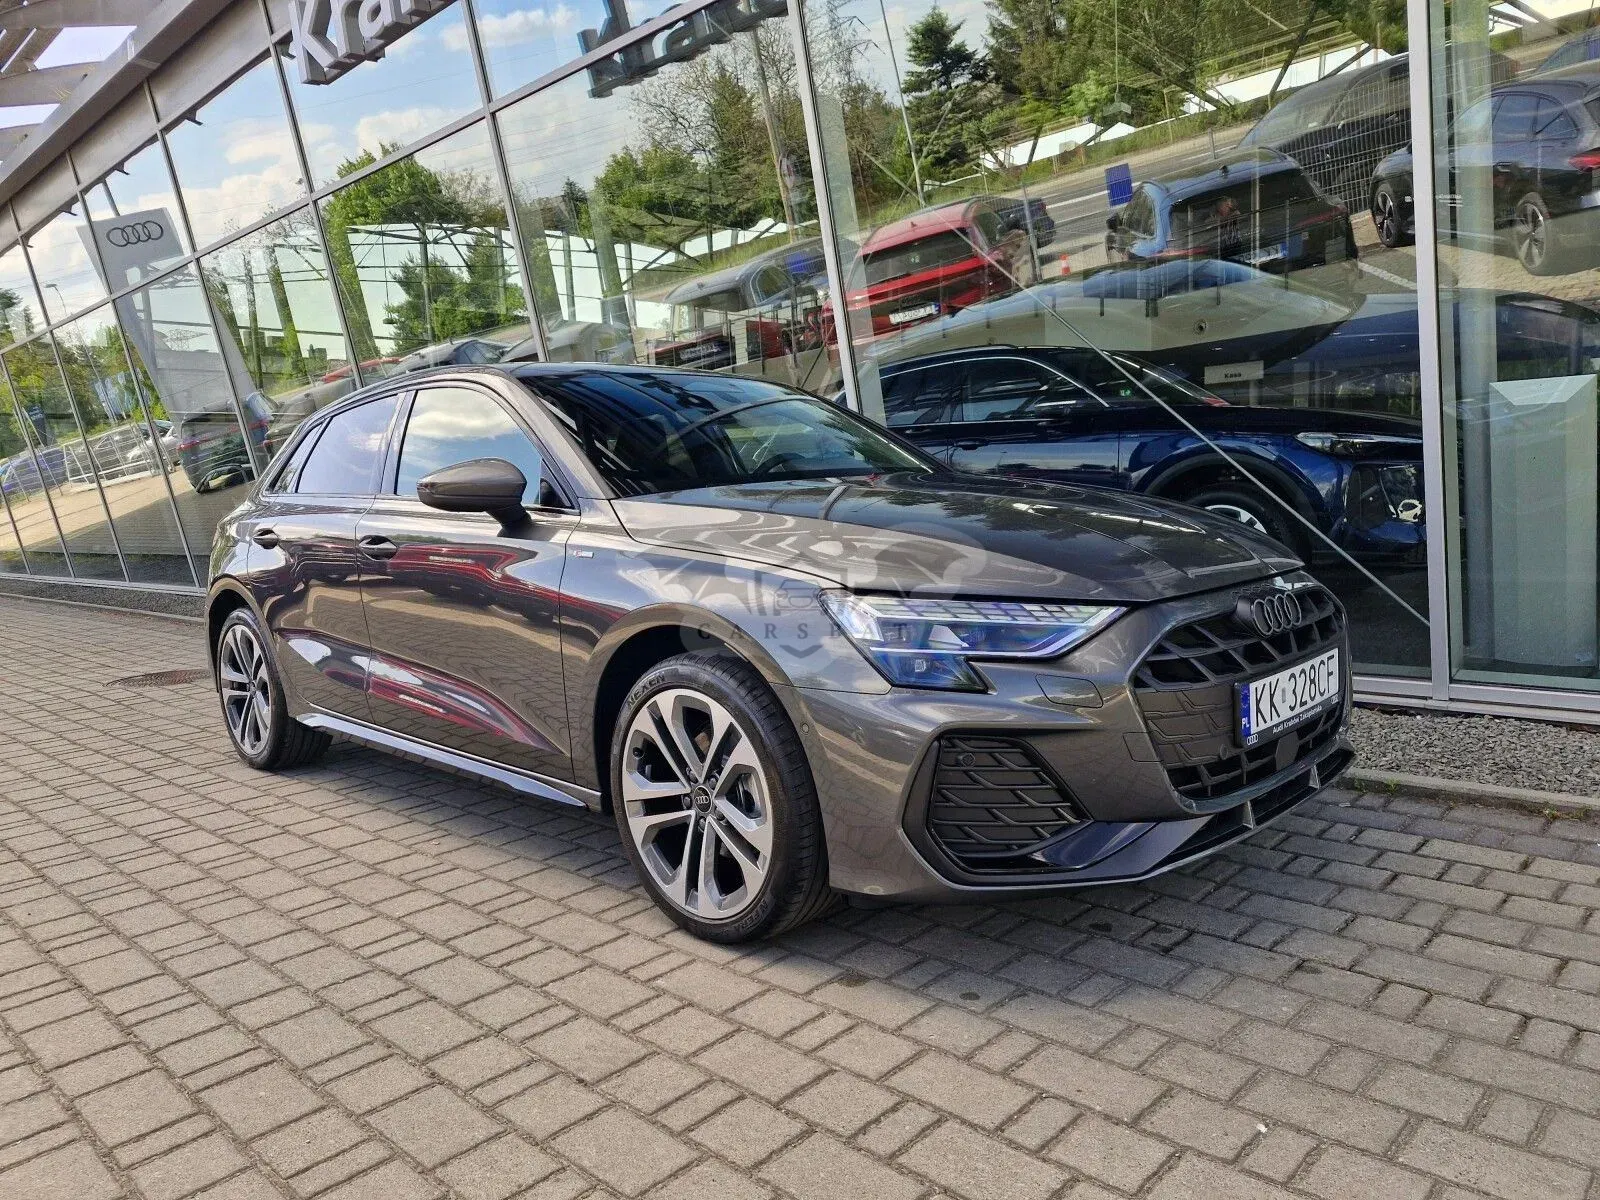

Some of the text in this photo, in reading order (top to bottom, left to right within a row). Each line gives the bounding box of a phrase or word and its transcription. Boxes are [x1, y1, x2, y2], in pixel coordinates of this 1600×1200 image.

[1255, 654, 1335, 727] KK 328CF
[1241, 717, 1250, 730] PL
